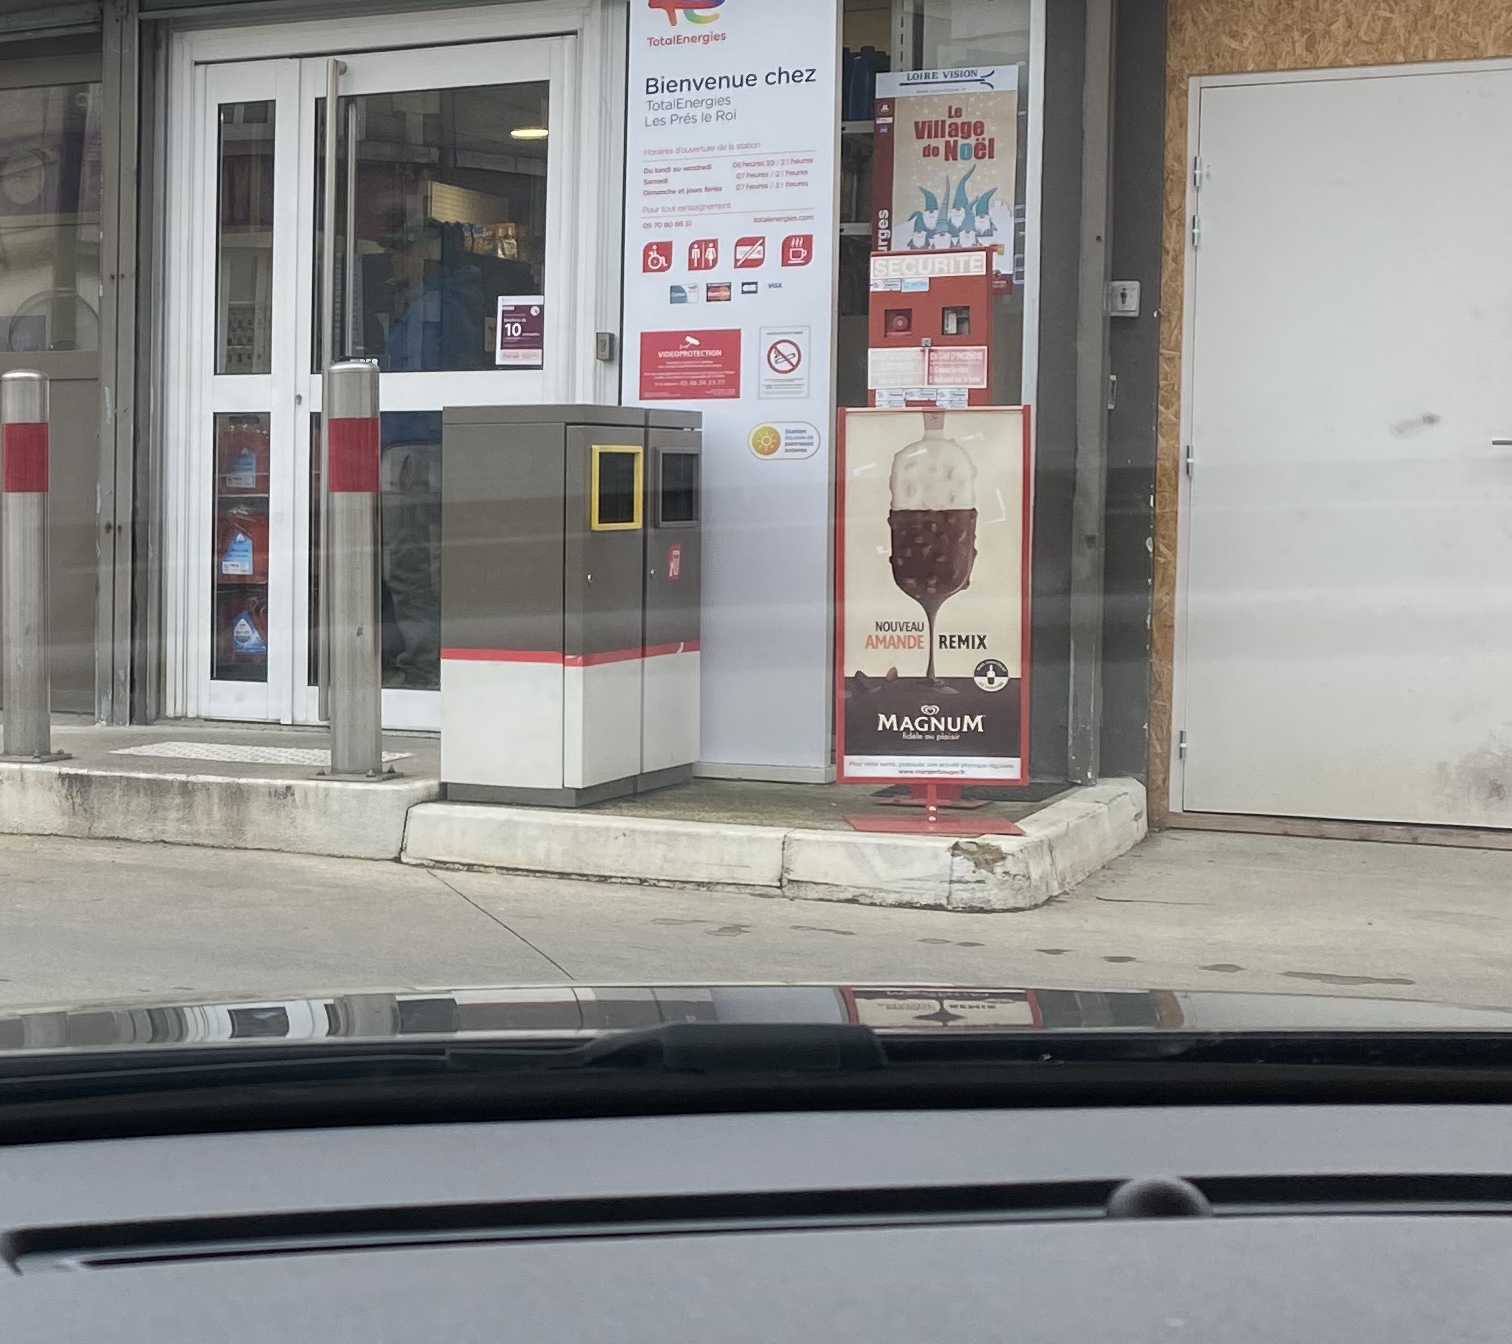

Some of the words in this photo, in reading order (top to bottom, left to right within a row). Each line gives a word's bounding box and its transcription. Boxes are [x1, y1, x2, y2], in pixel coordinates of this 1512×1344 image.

[646, 30, 727, 47] TotalEnergies
[645, 72, 758, 95] Bienvenue
[764, 66, 817, 86] chez
[906, 71, 939, 81] LOIRE
[942, 69, 979, 80] VISION
[645, 95, 732, 112] TotalEnergies
[947, 104, 963, 119] Le
[644, 115, 666, 128] Les
[669, 112, 697, 126] Prés
[701, 111, 712, 124] le
[715, 109, 737, 122] Roi
[913, 119, 985, 140] Village
[736, 141, 761, 150] station
[944, 138, 996, 162] Noël
[643, 166, 654, 175] Du
[654, 165, 672, 174] lundi
[873, 254, 983, 277] SECURITE
[504, 323, 522, 337] 10
[875, 621, 925, 632] NOUVEAU
[864, 634, 925, 650] AMANDE
[938, 634, 988, 650] REMIX
[877, 713, 985, 733] MAGNUM
[936, 732, 961, 742] plaisir
